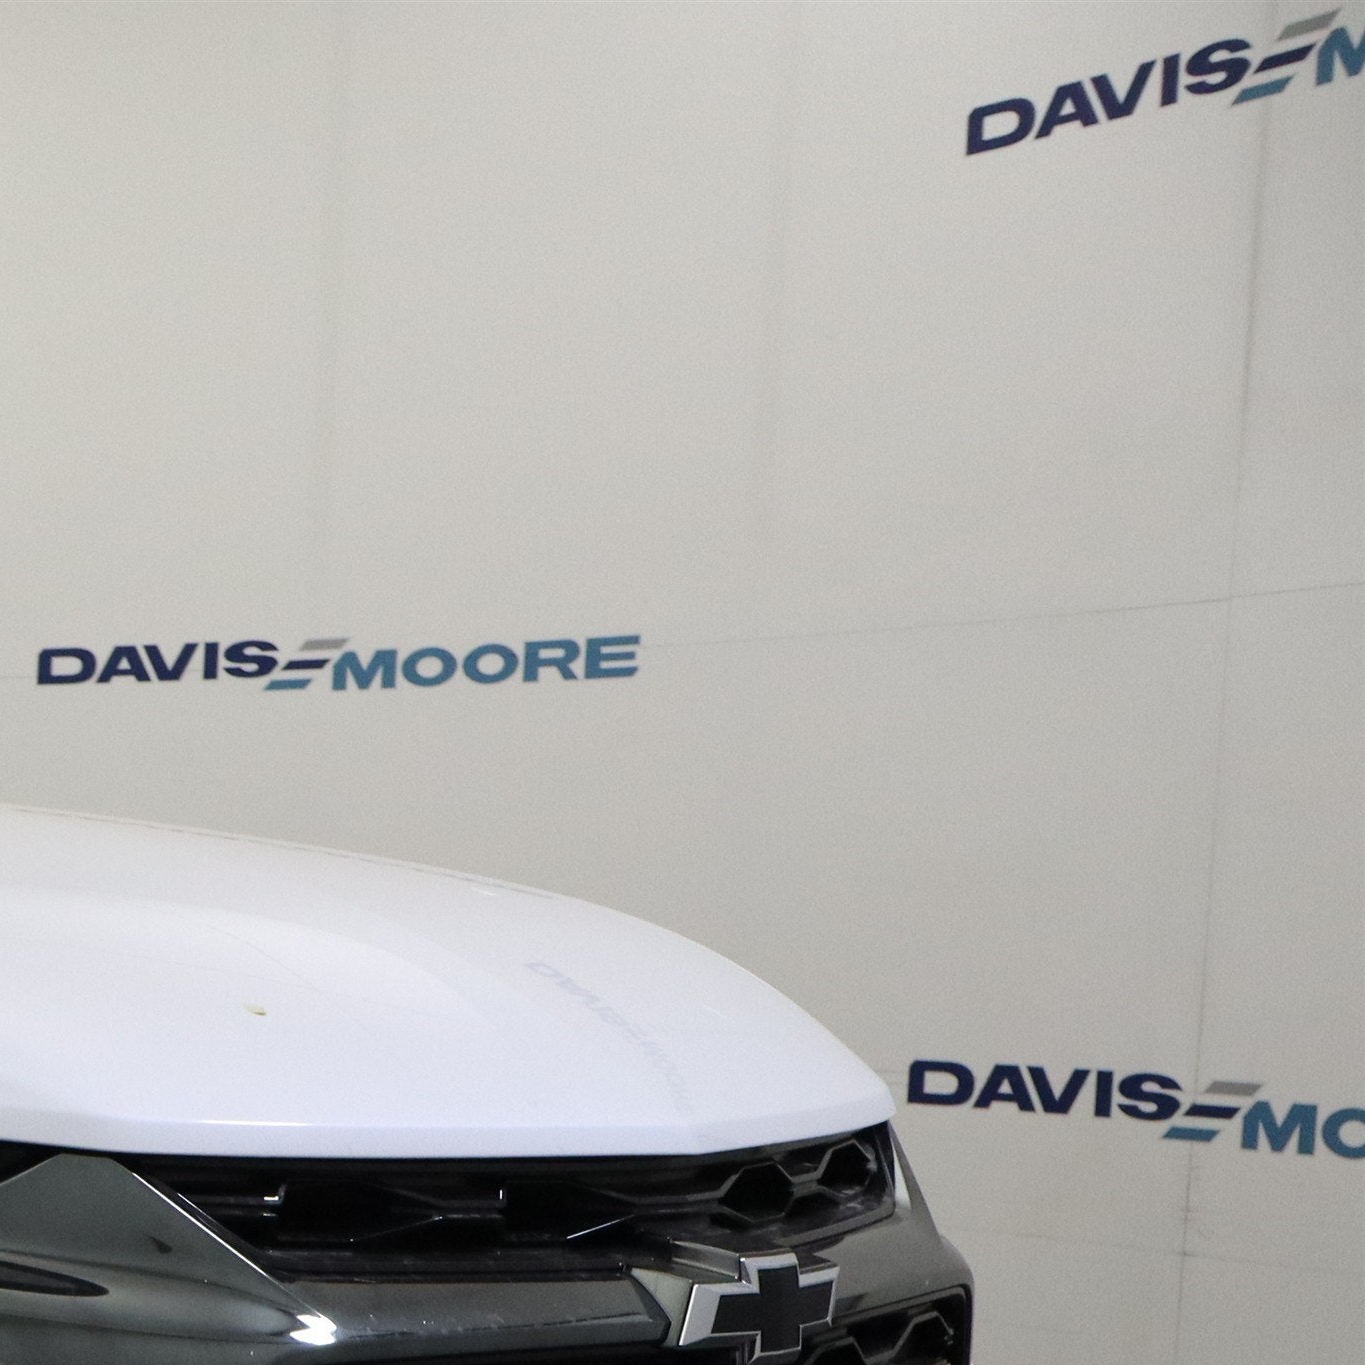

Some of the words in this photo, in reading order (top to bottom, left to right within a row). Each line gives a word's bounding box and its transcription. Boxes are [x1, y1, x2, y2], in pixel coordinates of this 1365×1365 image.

[966, 38, 1252, 156] DAVIS
[37, 640, 279, 685] DAVIS
[331, 635, 641, 691] MOORE
[907, 1059, 1182, 1121] DAVIS
